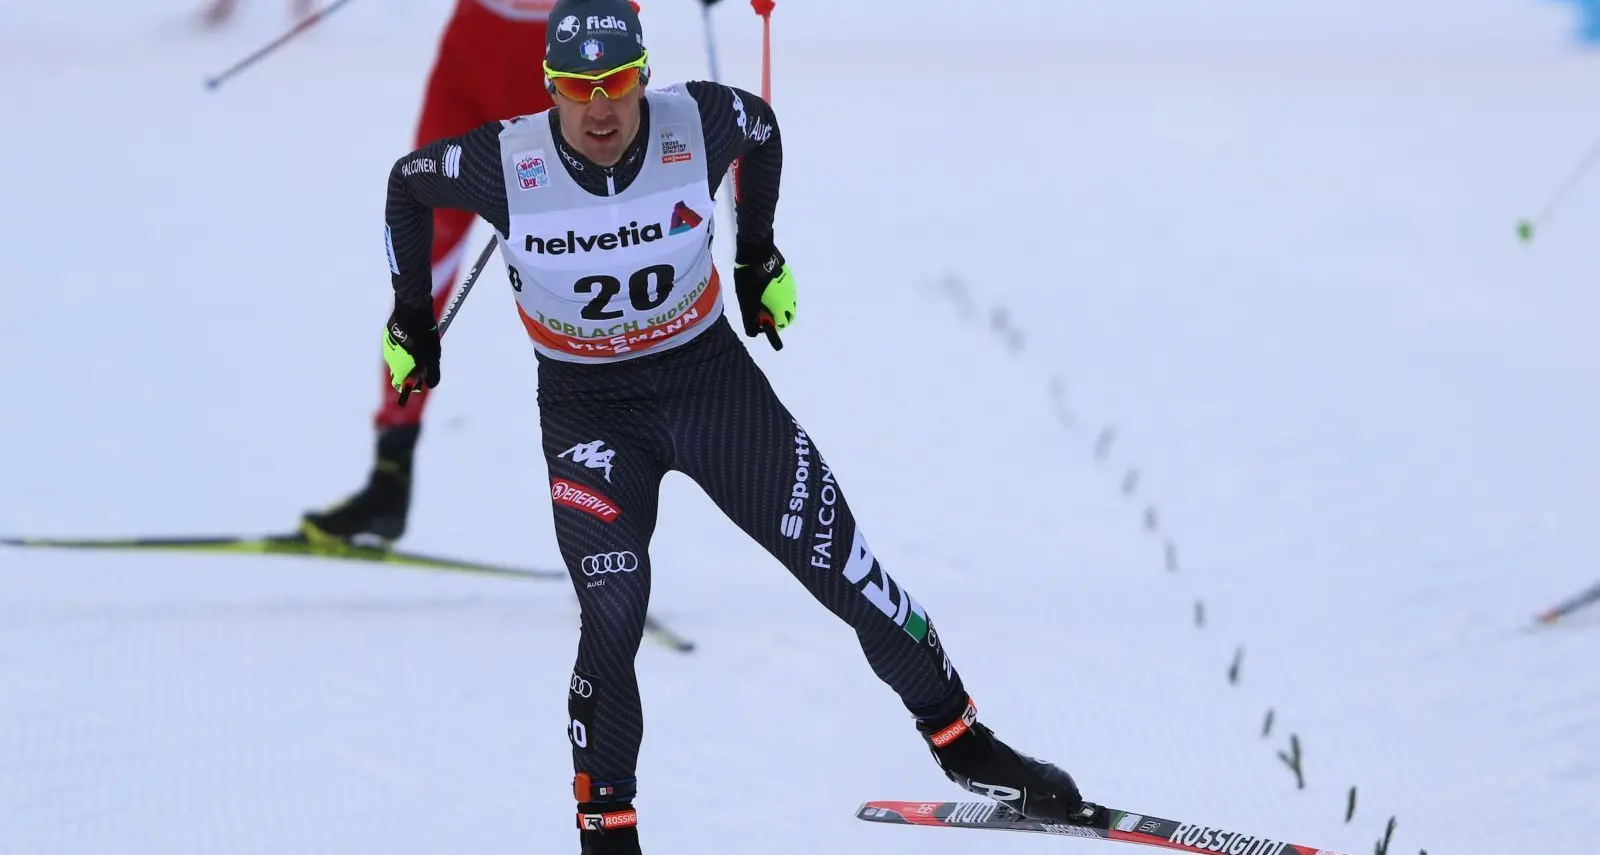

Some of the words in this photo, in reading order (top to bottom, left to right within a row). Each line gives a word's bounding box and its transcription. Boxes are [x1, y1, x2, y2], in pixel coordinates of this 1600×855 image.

[586, 15, 628, 31] fidia
[525, 220, 664, 255] helvetia
[573, 264, 675, 321] 20
[536, 309, 639, 339] TOBLACH
[564, 488, 617, 517] ENERVIT
[810, 451, 837, 570] FALCON
[586, 578, 606, 589] Audi
[605, 814, 637, 826] ROSSIG
[1168, 822, 1290, 855] ROSSIGNOL
